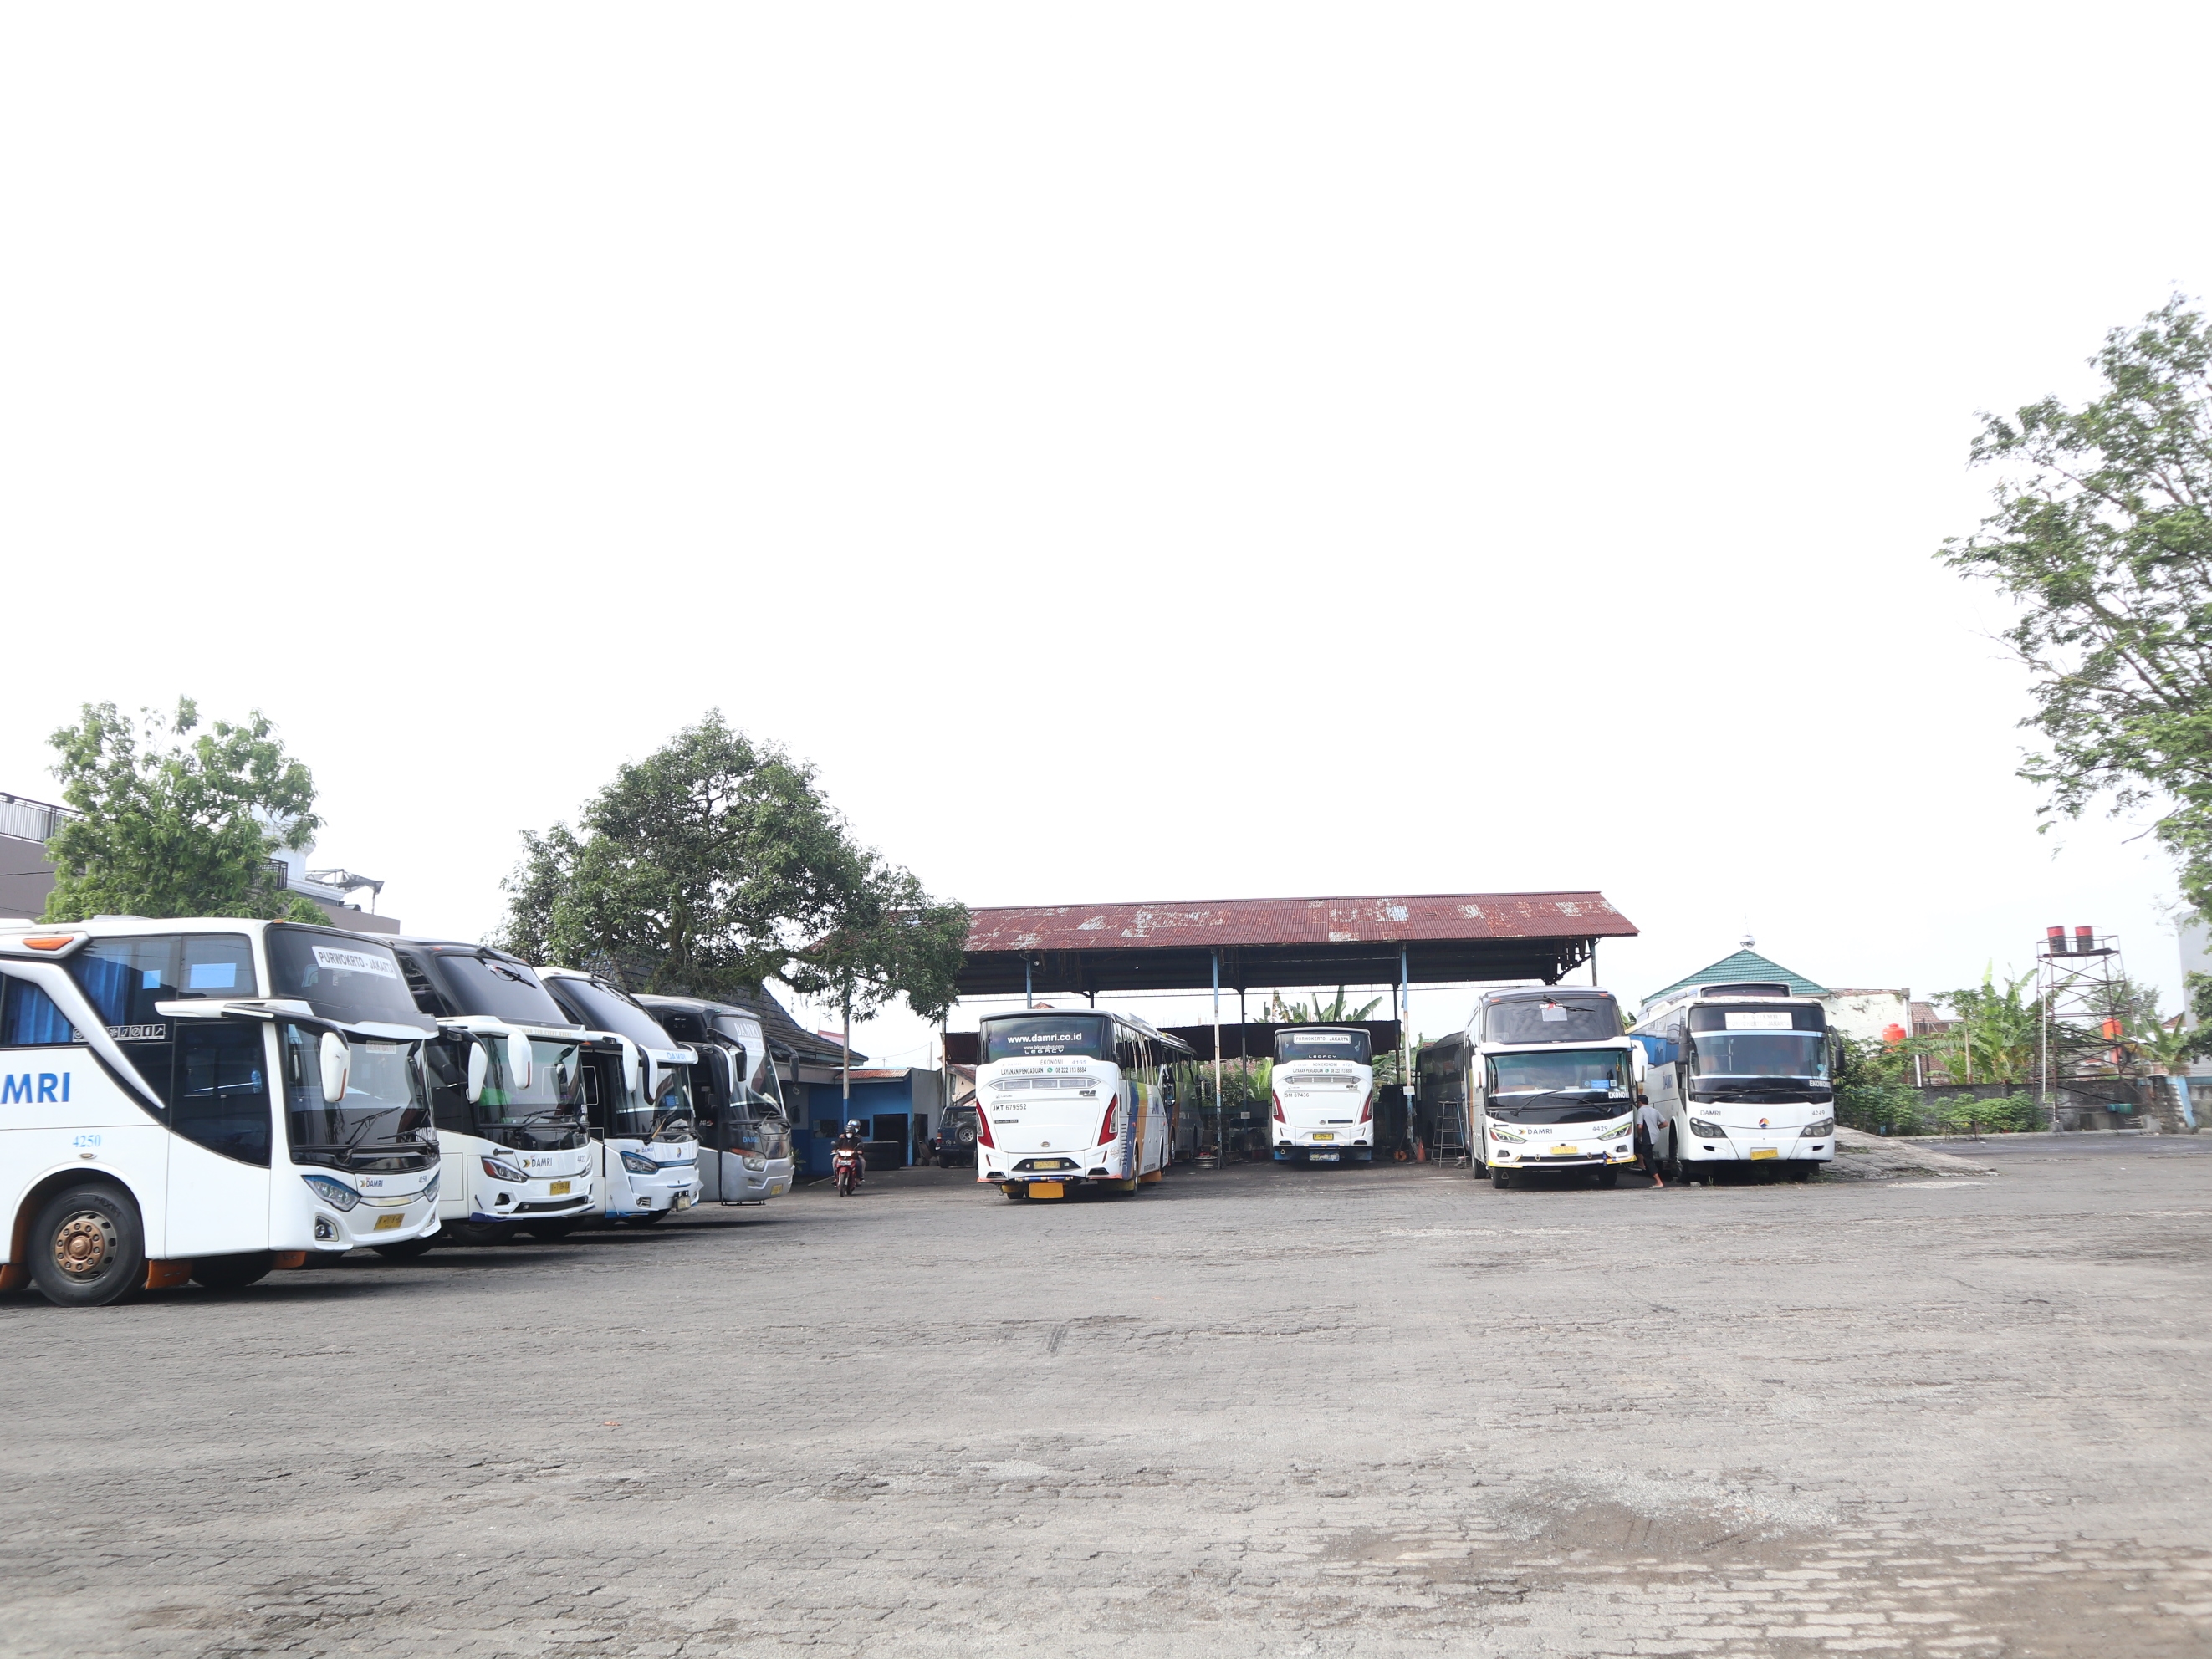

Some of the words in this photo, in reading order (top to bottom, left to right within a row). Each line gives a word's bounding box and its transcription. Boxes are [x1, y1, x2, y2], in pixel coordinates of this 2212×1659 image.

[318, 952, 365, 967] PURWOKRTO
[369, 958, 394, 973] JAKARTA
[734, 1023, 760, 1038] DAMRI
[1007, 1033, 1082, 1044] www.damri.co.id
[72, 1135, 101, 1148] 4250
[531, 1158, 553, 1167] DAMRI
